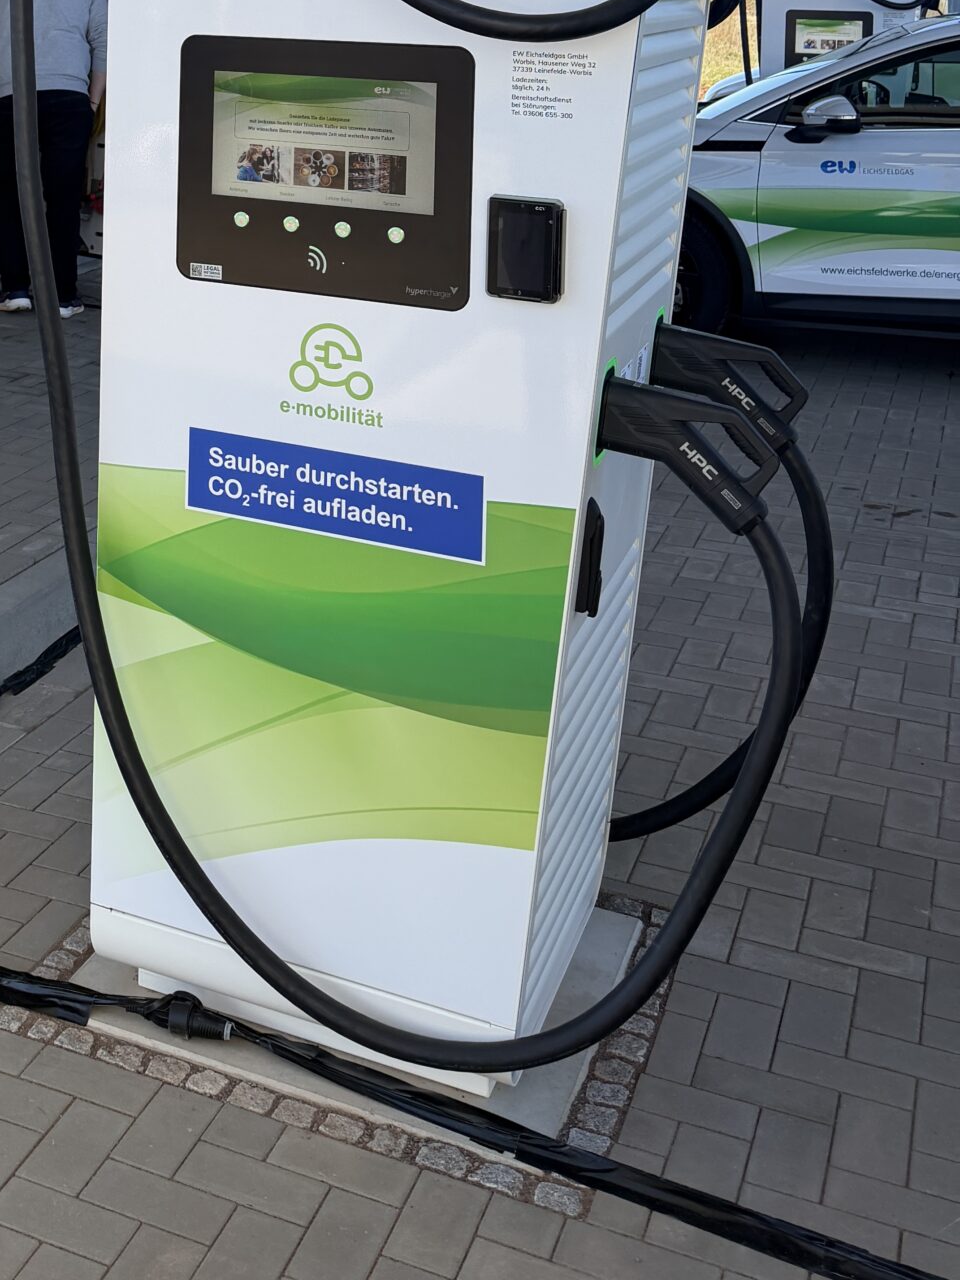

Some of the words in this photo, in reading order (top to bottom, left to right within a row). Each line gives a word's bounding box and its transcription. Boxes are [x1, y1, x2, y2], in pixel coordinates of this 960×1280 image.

[525, 51, 566, 60] Eichsfeldgas
[570, 61, 586, 69] Weg
[820, 160, 857, 174] ew
[862, 168, 915, 176] EICHSFELDGAS
[721, 377, 757, 411] HPC
[679, 441, 719, 481] HPC
[208, 446, 289, 479] Sauber
[296, 463, 459, 510] durchstarten.
[302, 496, 413, 532] aufladen.
